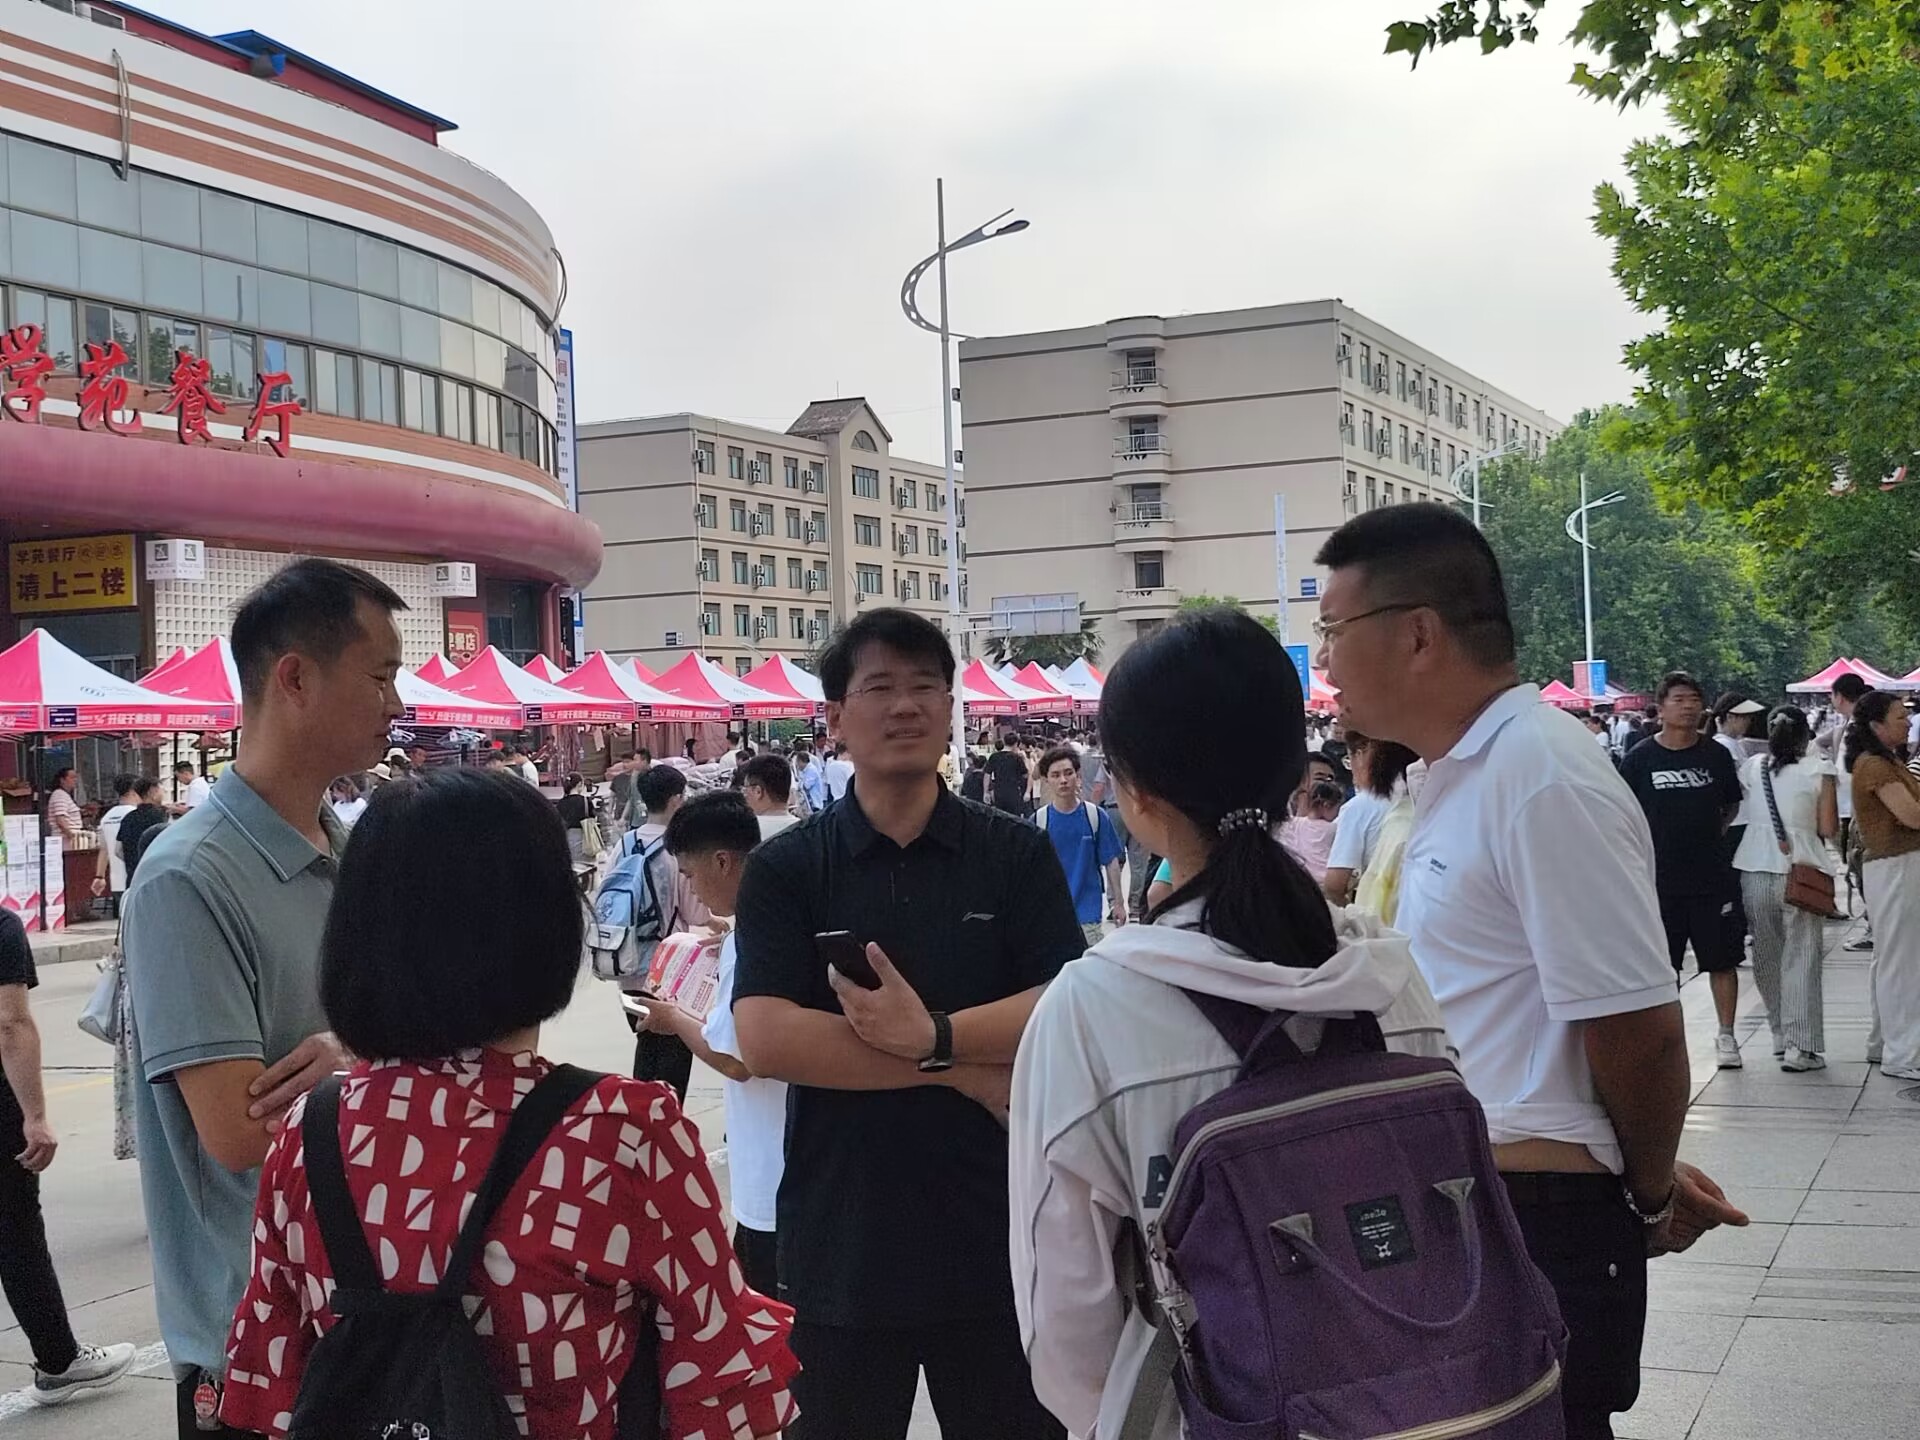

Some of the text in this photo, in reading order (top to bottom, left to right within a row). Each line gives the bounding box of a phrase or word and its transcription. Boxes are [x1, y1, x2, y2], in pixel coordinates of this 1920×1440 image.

[0, 322, 302, 457] 学苑餐厅
[16, 566, 125, 601] 请上二楼
